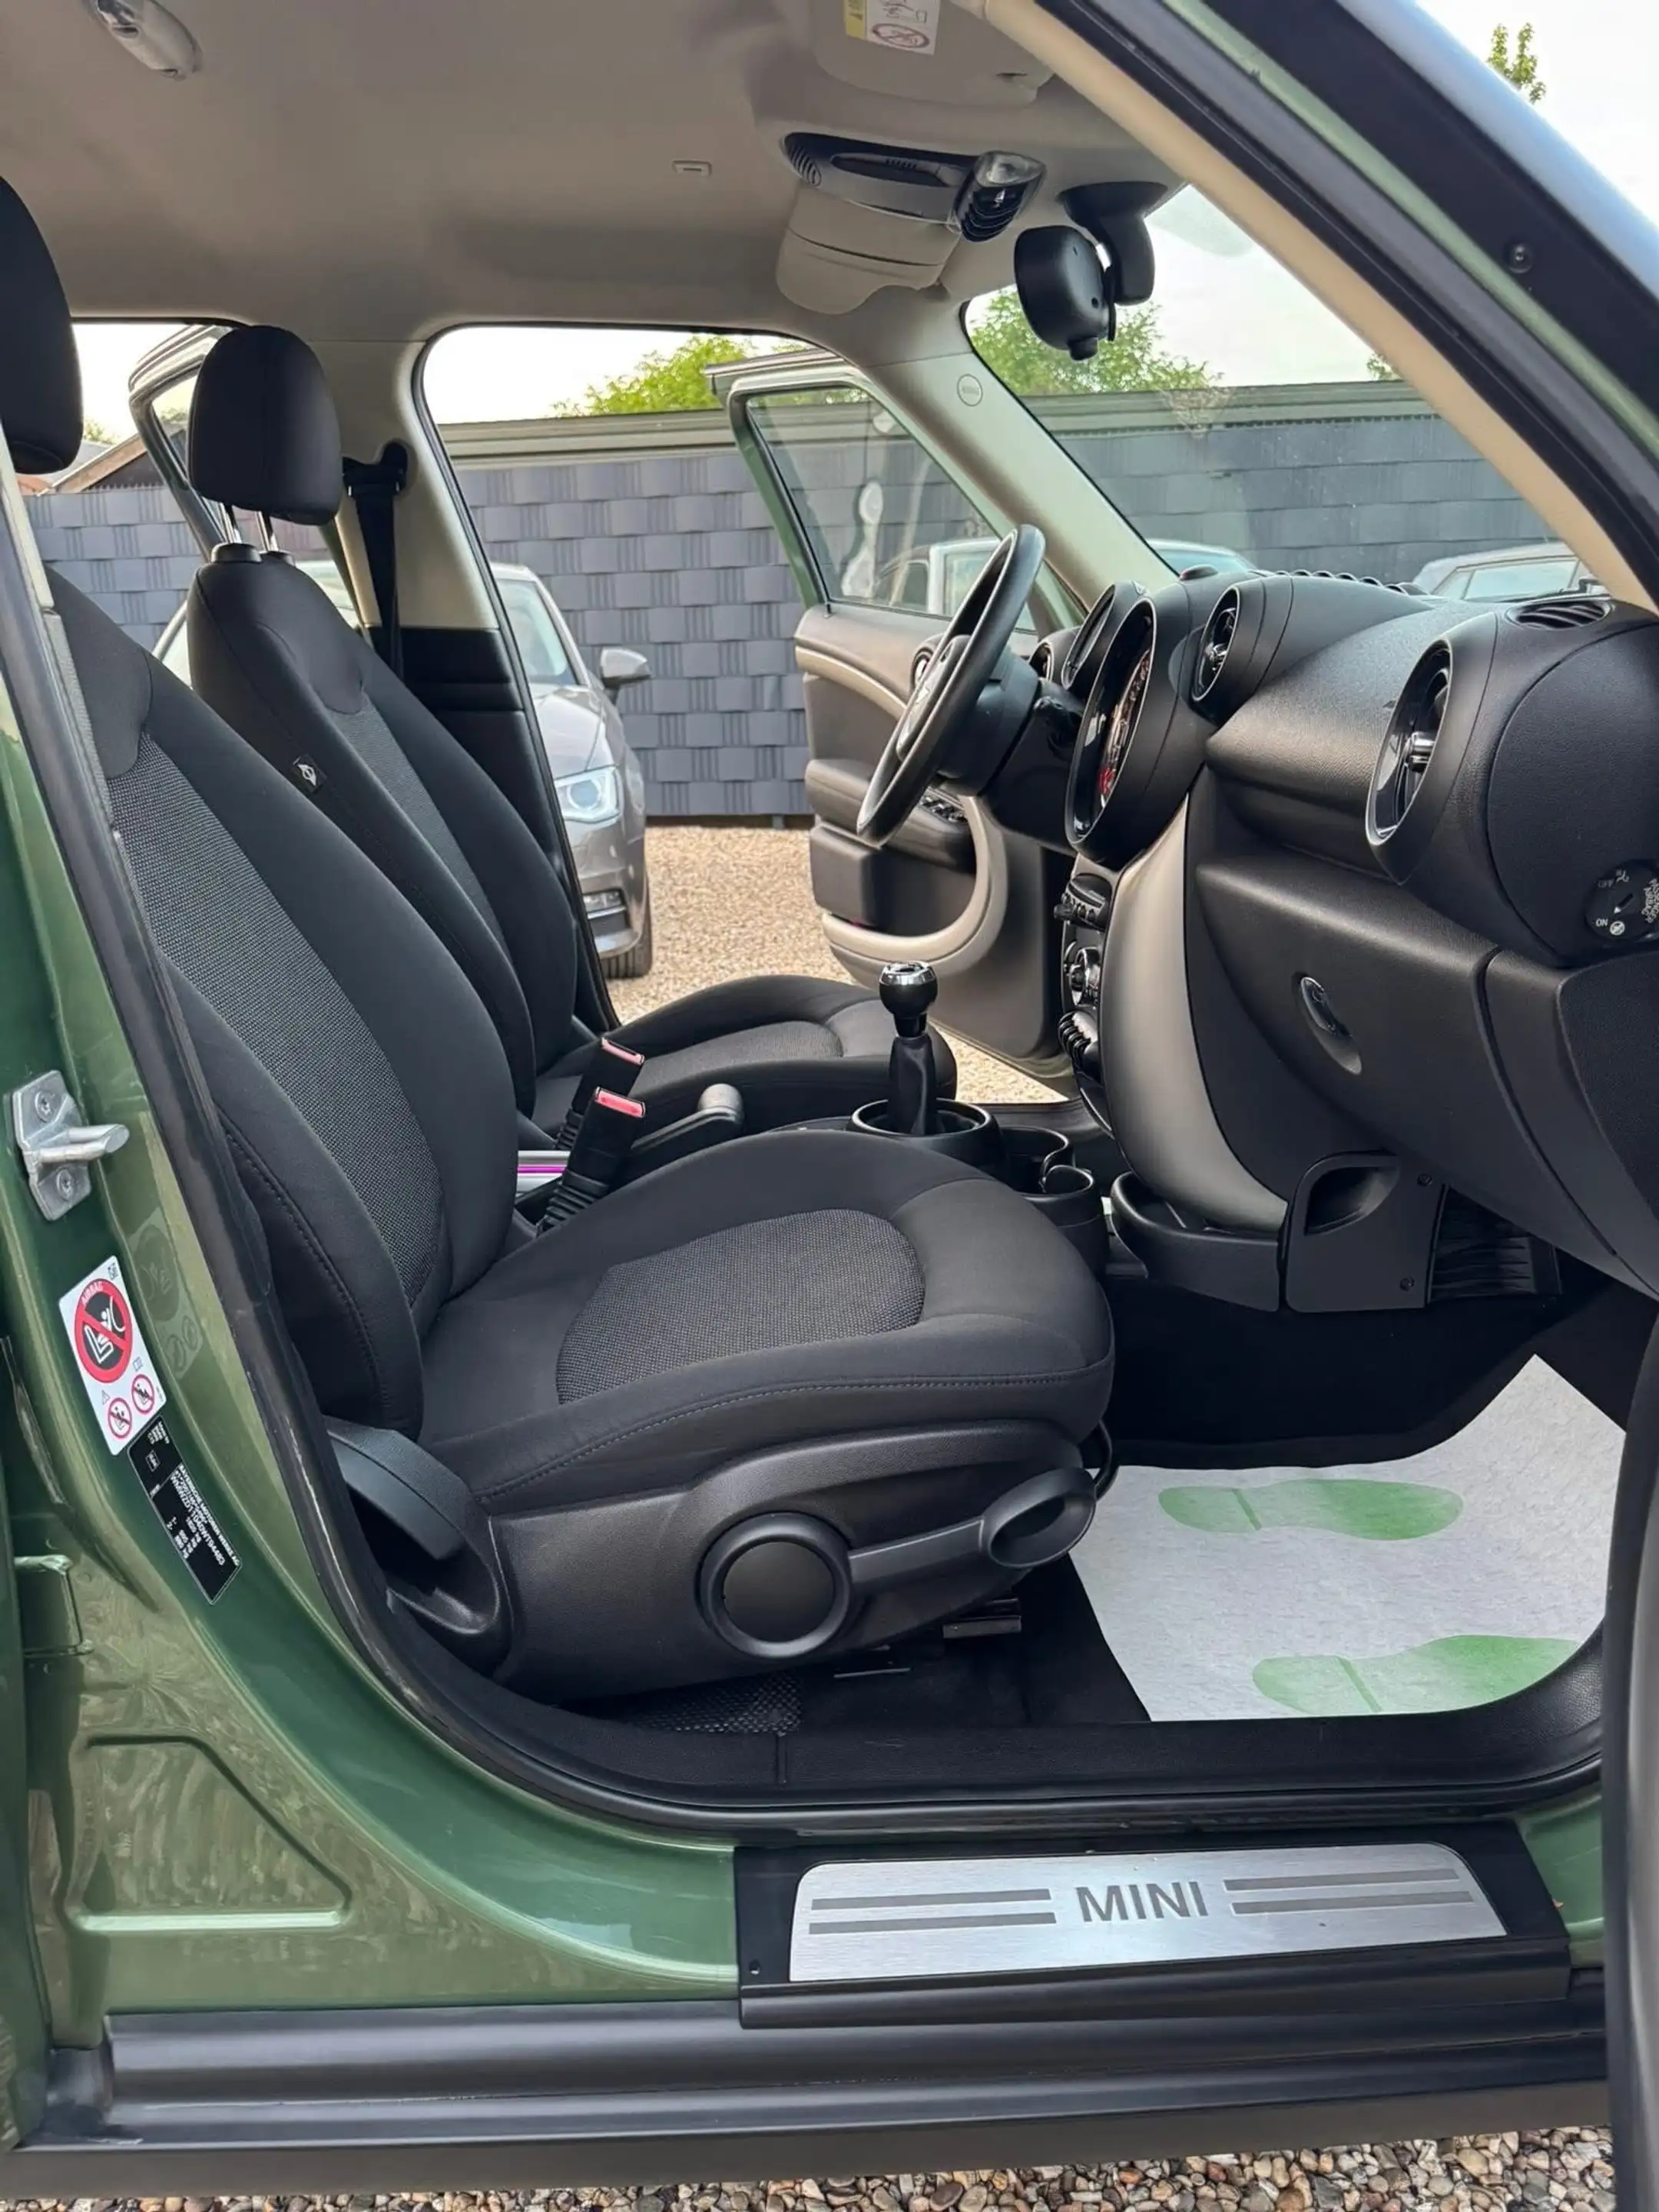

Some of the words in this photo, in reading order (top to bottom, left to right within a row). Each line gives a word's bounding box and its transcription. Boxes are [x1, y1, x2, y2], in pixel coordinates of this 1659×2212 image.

[1641, 887, 1653, 916] AIRBAG
[1595, 918, 1608, 927] ON
[81, 1281, 104, 1306] AIRBAG
[199, 1501, 220, 1536] MOTOREN
[230, 1553, 240, 1566] AG
[1075, 1881, 1208, 1922] MINI
